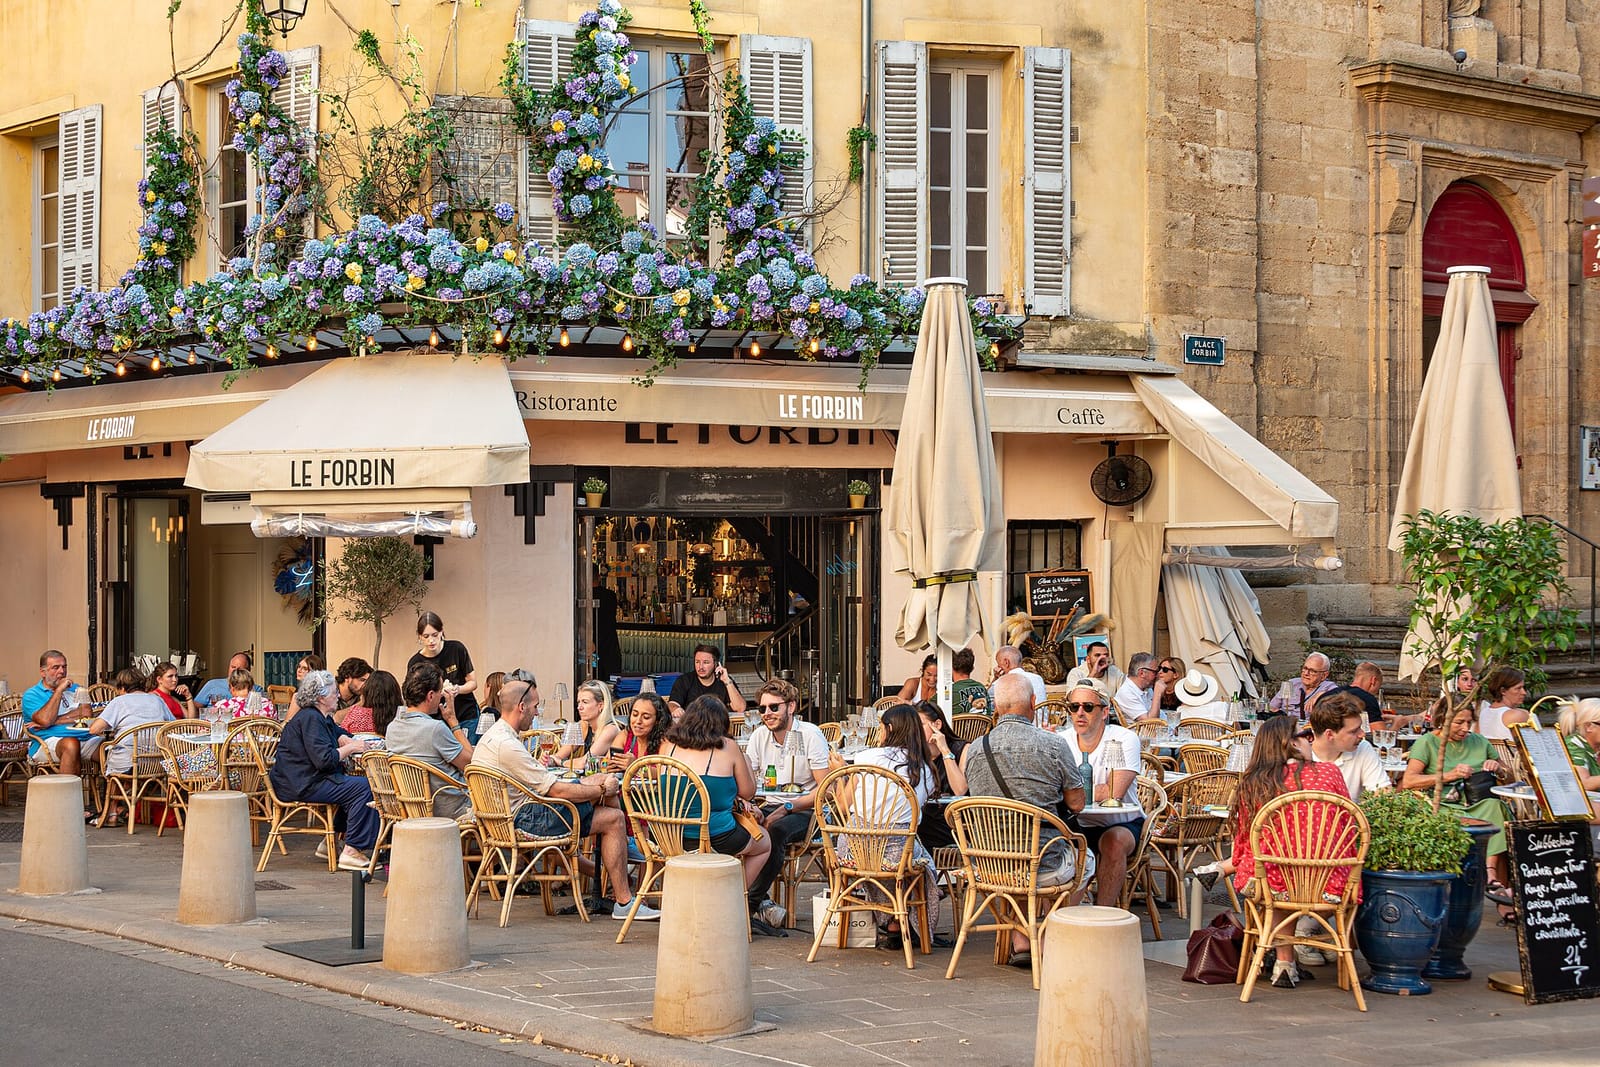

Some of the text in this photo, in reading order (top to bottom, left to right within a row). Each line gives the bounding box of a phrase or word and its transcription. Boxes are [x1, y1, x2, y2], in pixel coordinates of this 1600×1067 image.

[1191, 348, 1217, 357] FORBIN
[1194, 340, 1215, 349] PLACE
[514, 390, 618, 412] Ristorante
[779, 394, 863, 420] LE FORBIN
[1057, 407, 1105, 425] Caffè
[87, 415, 136, 441] LE FORBIN
[291, 458, 395, 487] LE FORBIN
[828, 920, 867, 928] MGO
